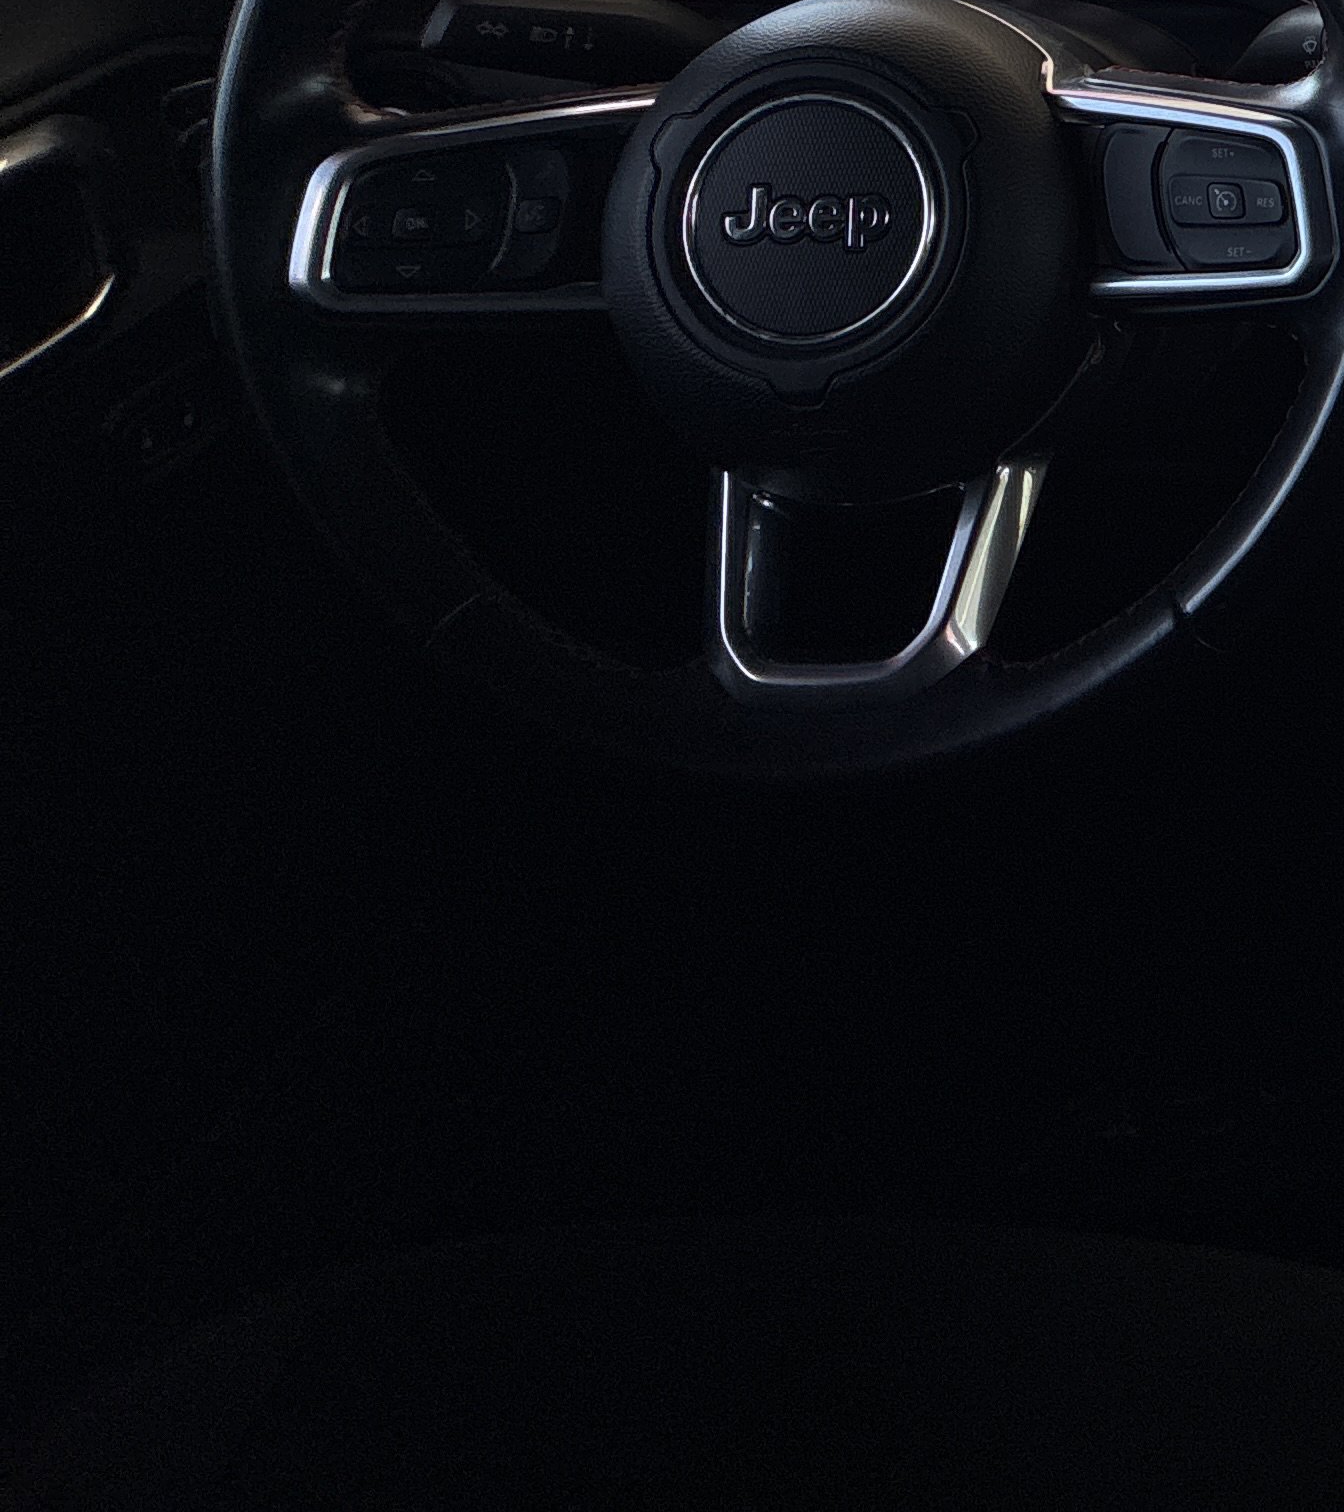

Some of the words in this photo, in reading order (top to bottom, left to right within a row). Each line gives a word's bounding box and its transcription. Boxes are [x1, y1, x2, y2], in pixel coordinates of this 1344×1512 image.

[1174, 196, 1202, 206] CANC
[1257, 197, 1274, 207] RES
[723, 186, 891, 249] Jeep
